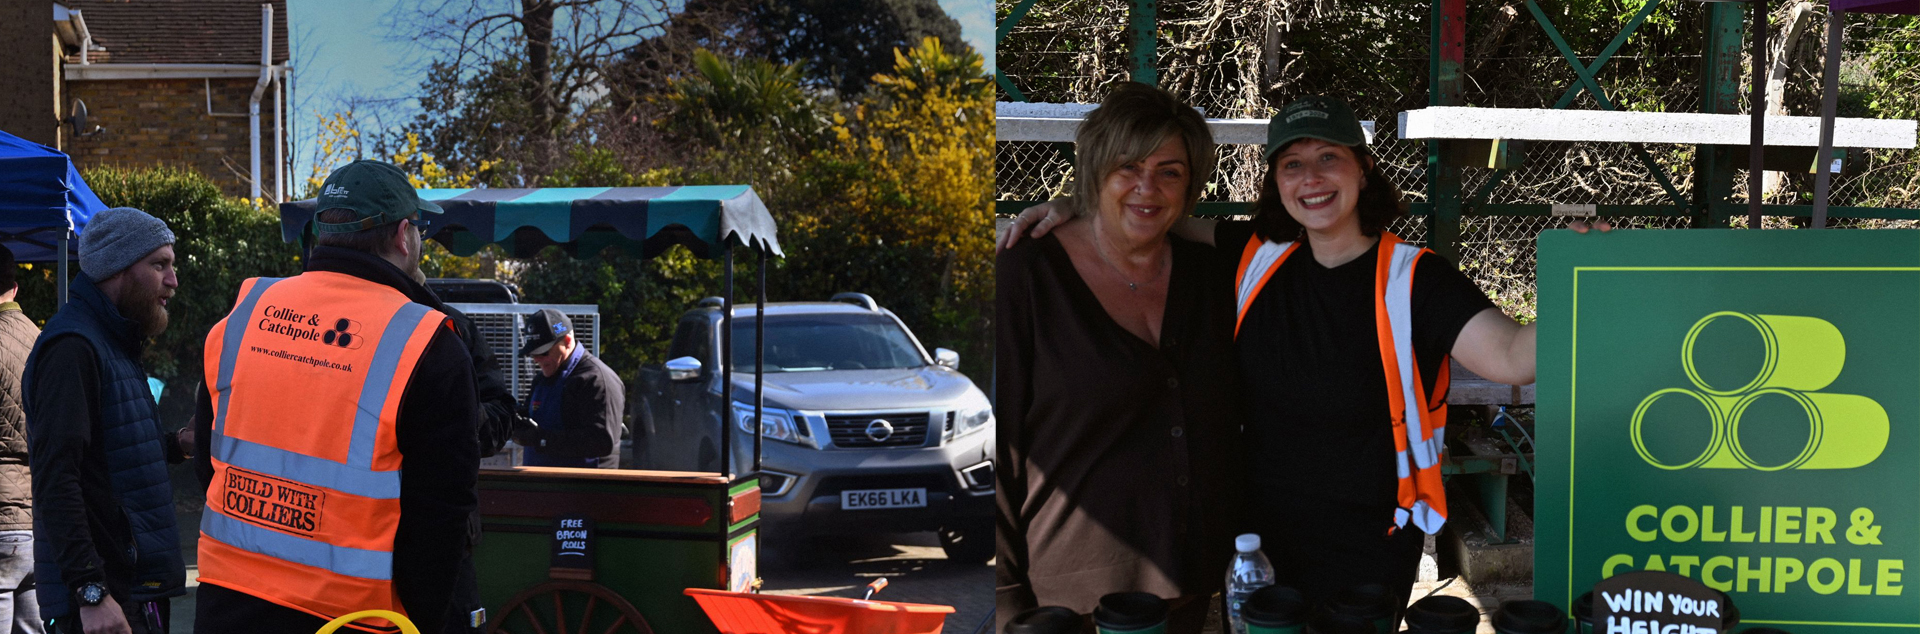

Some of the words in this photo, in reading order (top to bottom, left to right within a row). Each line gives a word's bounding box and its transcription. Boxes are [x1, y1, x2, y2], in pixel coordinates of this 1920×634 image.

[264, 305, 306, 323] Collier
[307, 314, 320, 326] &
[258, 318, 320, 341] Catchpole
[250, 345, 353, 373] www.colliercatchpole.co.uk
[228, 472, 273, 498] BUILD
[277, 485, 318, 510] WITH
[848, 492, 887, 507] EK66
[891, 490, 920, 505] LKA
[226, 491, 316, 532] COLLIERS
[556, 530, 587, 540] BACON
[561, 519, 583, 528] FREE
[1625, 504, 1837, 544] COLLIER
[1845, 507, 1883, 545] &
[562, 541, 586, 549] ROLLS
[1601, 588, 1663, 613] WIN
[1668, 593, 1720, 618] YOUR
